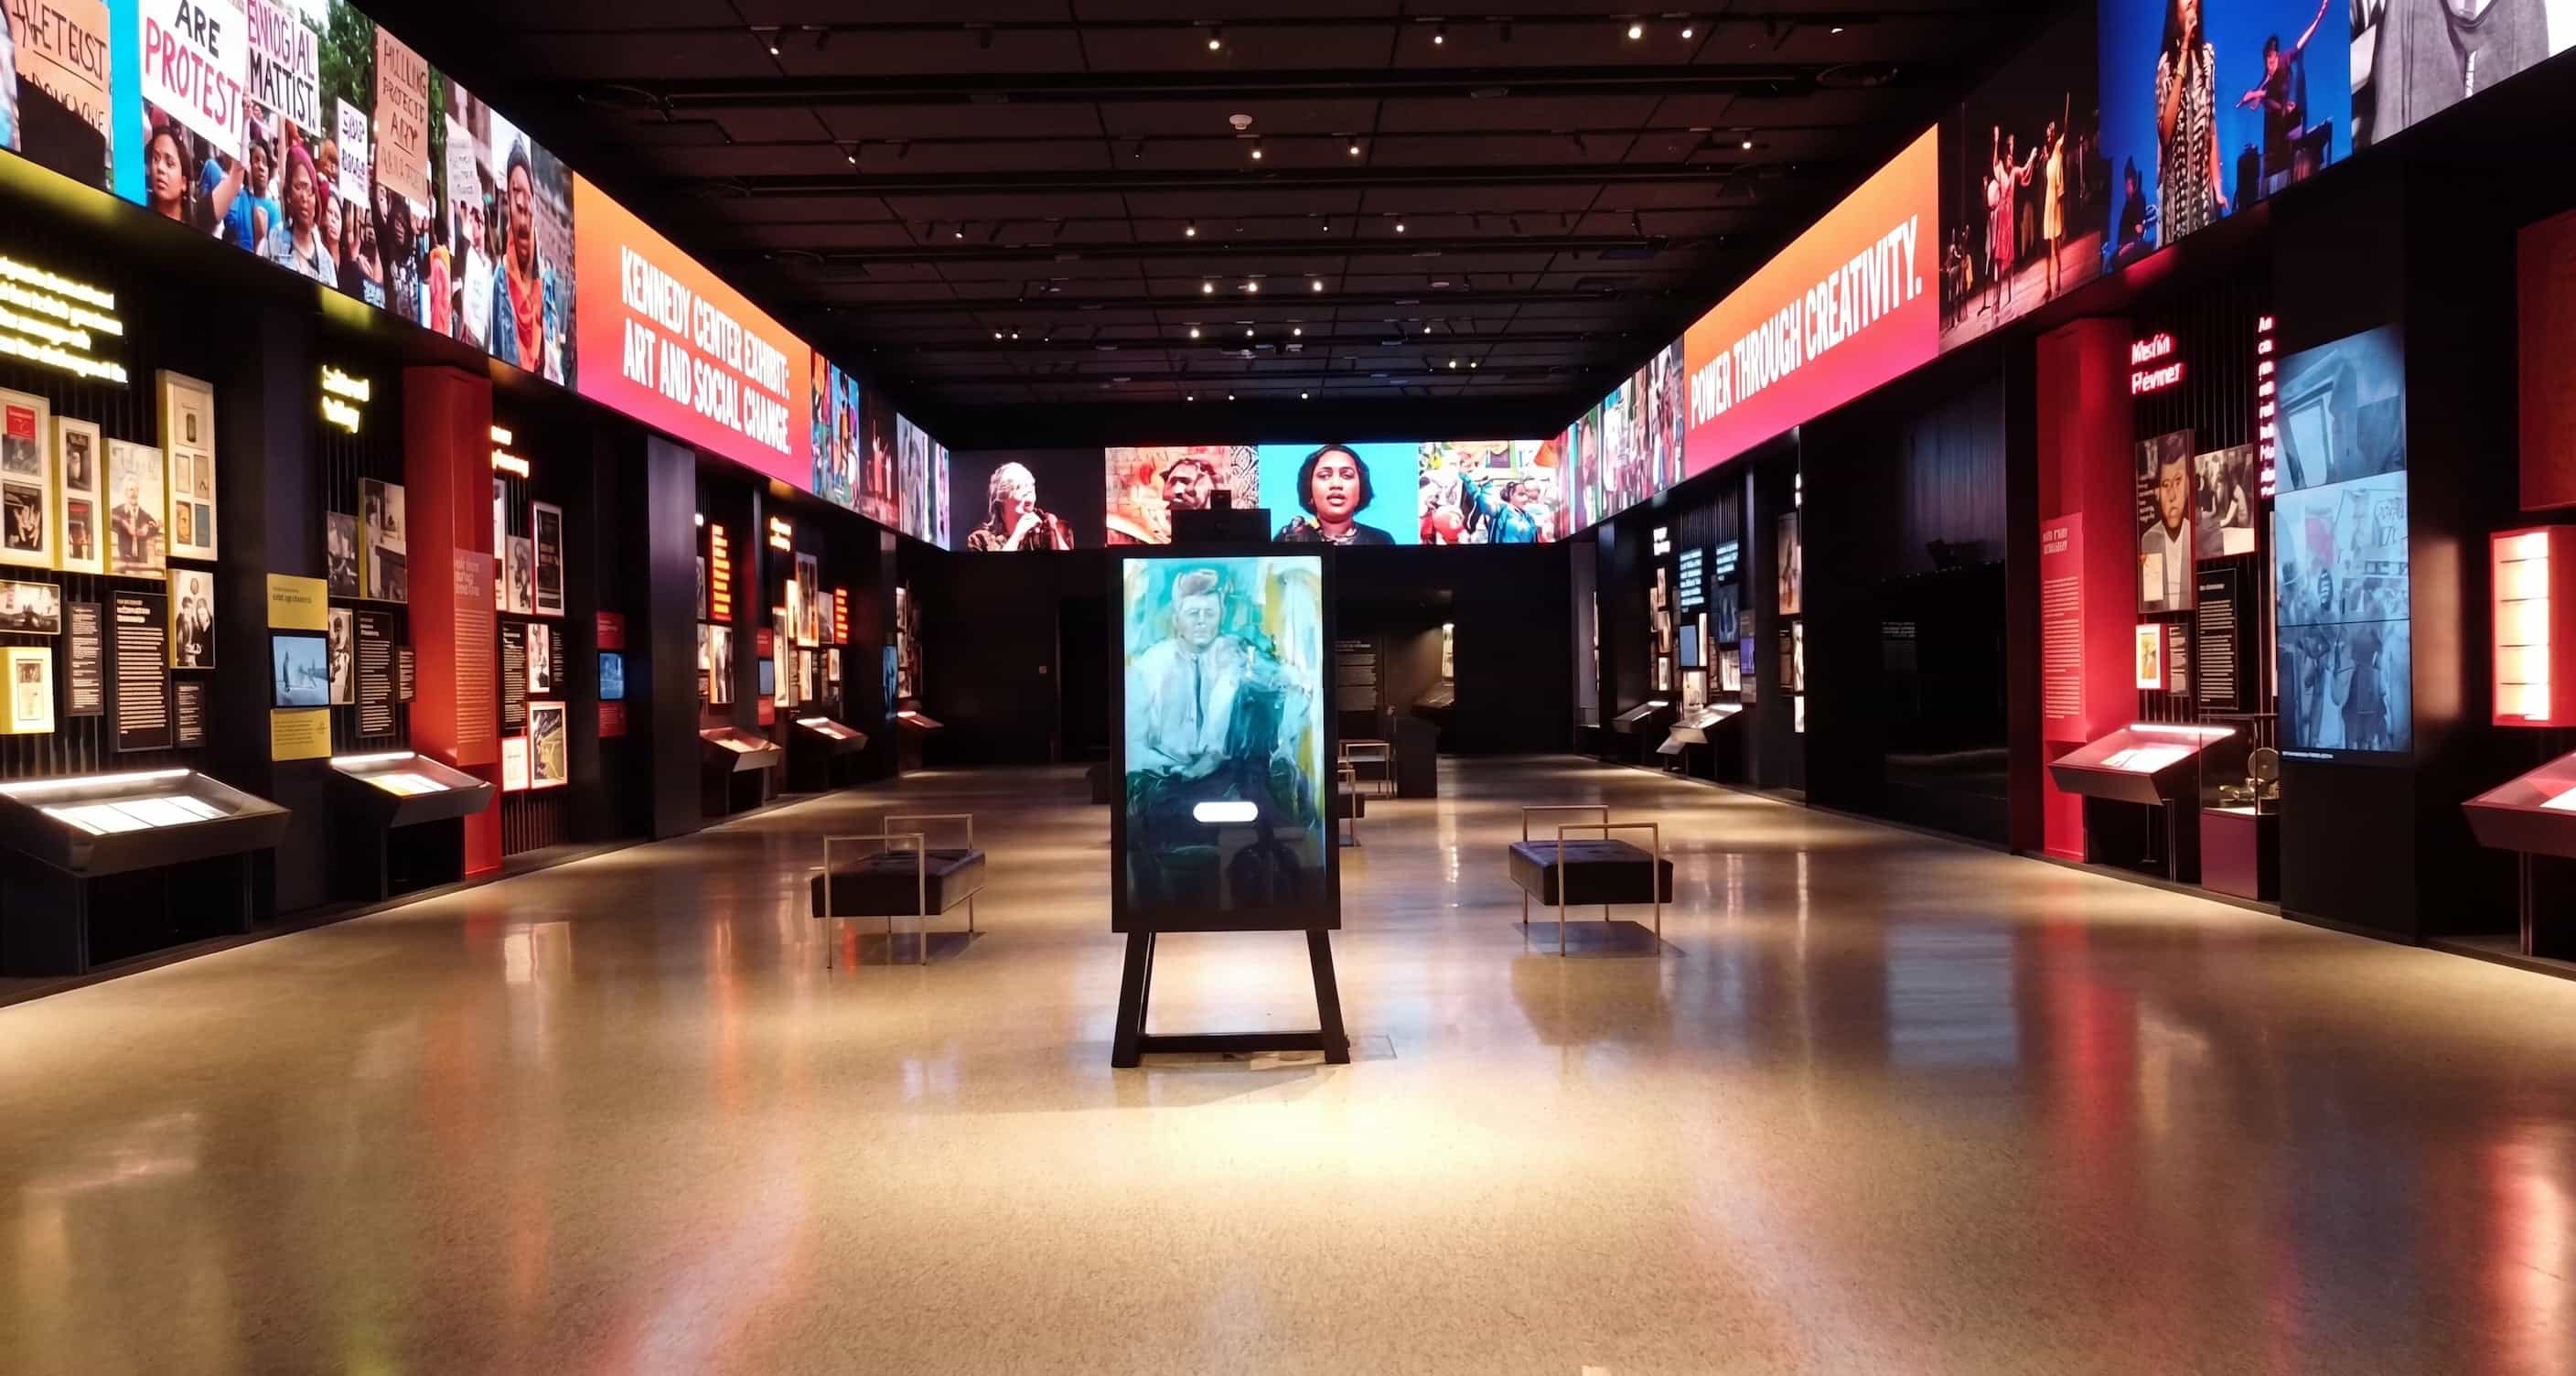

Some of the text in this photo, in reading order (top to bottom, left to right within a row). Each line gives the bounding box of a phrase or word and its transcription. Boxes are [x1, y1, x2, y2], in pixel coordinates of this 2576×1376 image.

[145, 16, 241, 134] PROTEST
[175, 0, 220, 59] ARE
[621, 243, 692, 339] KENNEDY
[694, 295, 743, 373] CENTER
[1690, 214, 1922, 430] POWER THROUGH CREATIVITY.
[624, 317, 792, 455] ART AND SOCIAL CHANGE.
